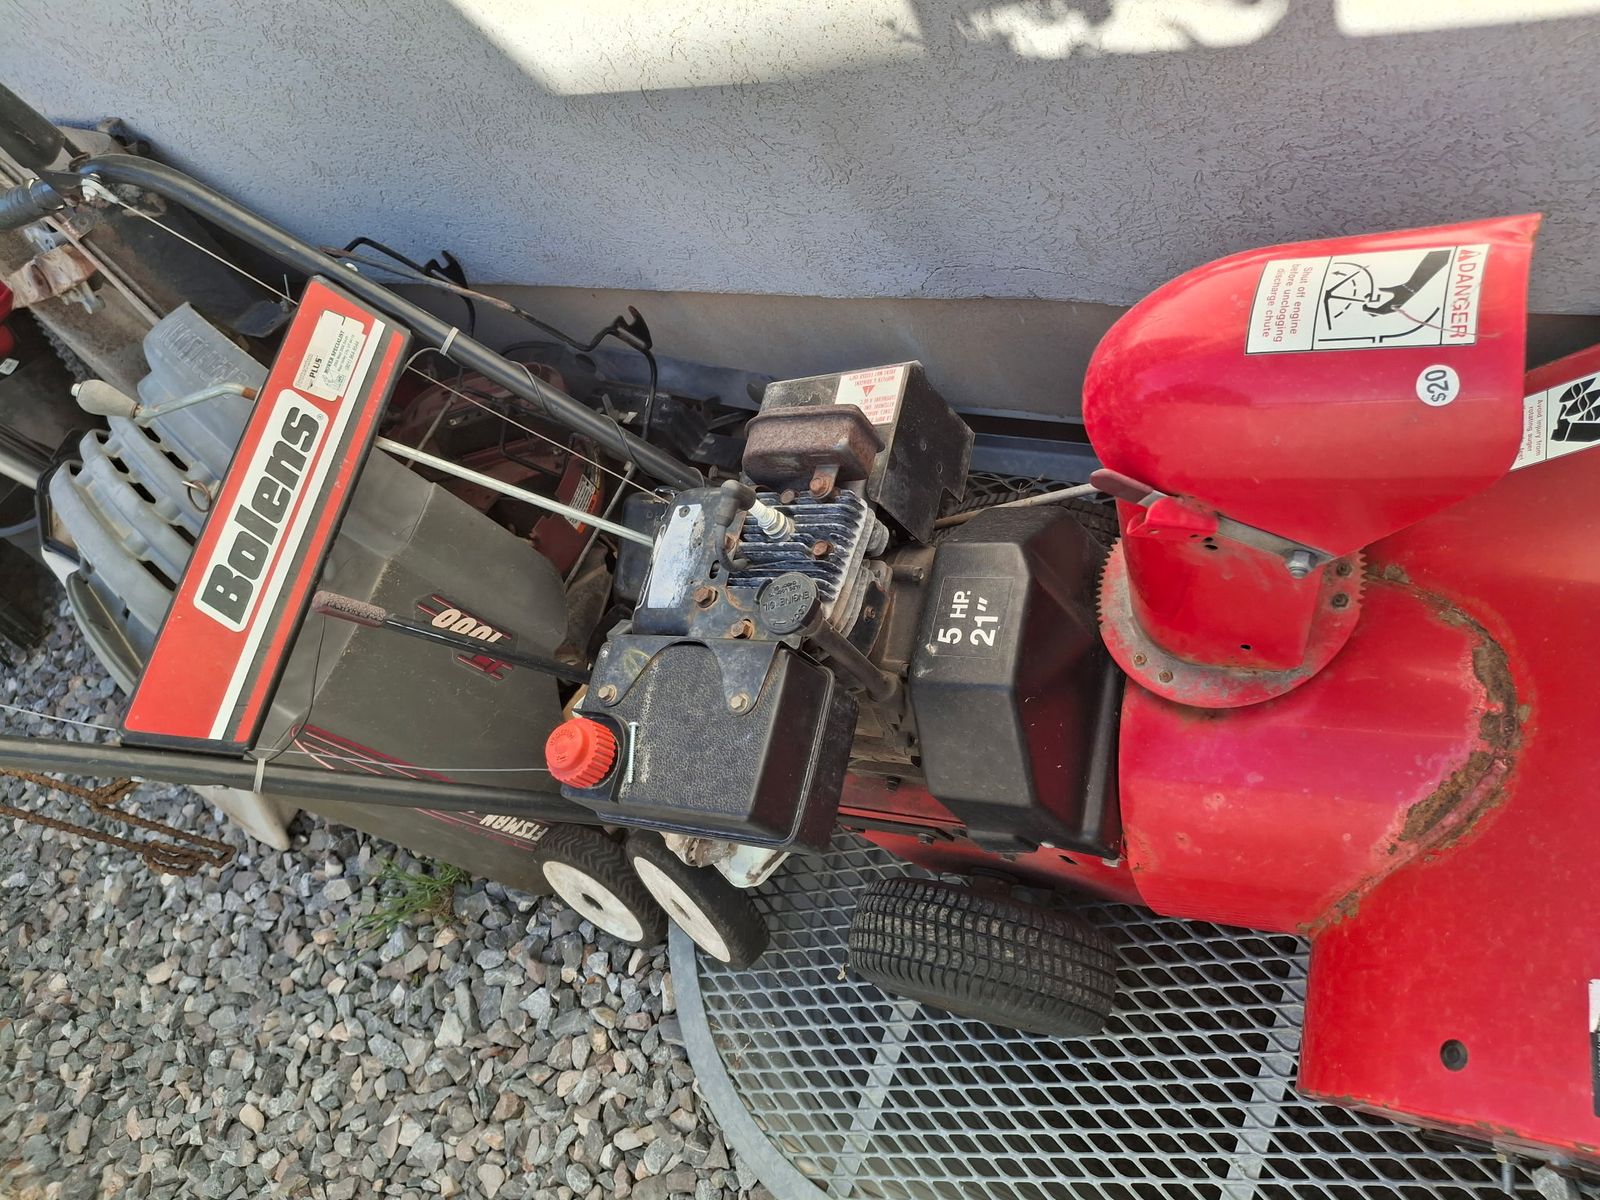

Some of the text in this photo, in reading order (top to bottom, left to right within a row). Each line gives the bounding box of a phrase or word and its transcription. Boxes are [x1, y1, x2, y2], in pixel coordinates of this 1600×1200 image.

[1263, 268, 1284, 338] discharge chute
[1273, 264, 1301, 342] before unclogging
[1290, 267, 1313, 335] Shut off engine
[1450, 263, 1476, 338] DANGER
[331, 330, 345, 358] SPECIALIST
[309, 357, 323, 379] PLUS
[1425, 369, 1449, 403] $20
[1536, 399, 1544, 417] Avoid
[1535, 440, 1543, 457] from
[201, 406, 320, 625] Bolens
[780, 590, 810, 607] ENGINE
[937, 627, 962, 645] 5
[969, 596, 999, 647] 21"
